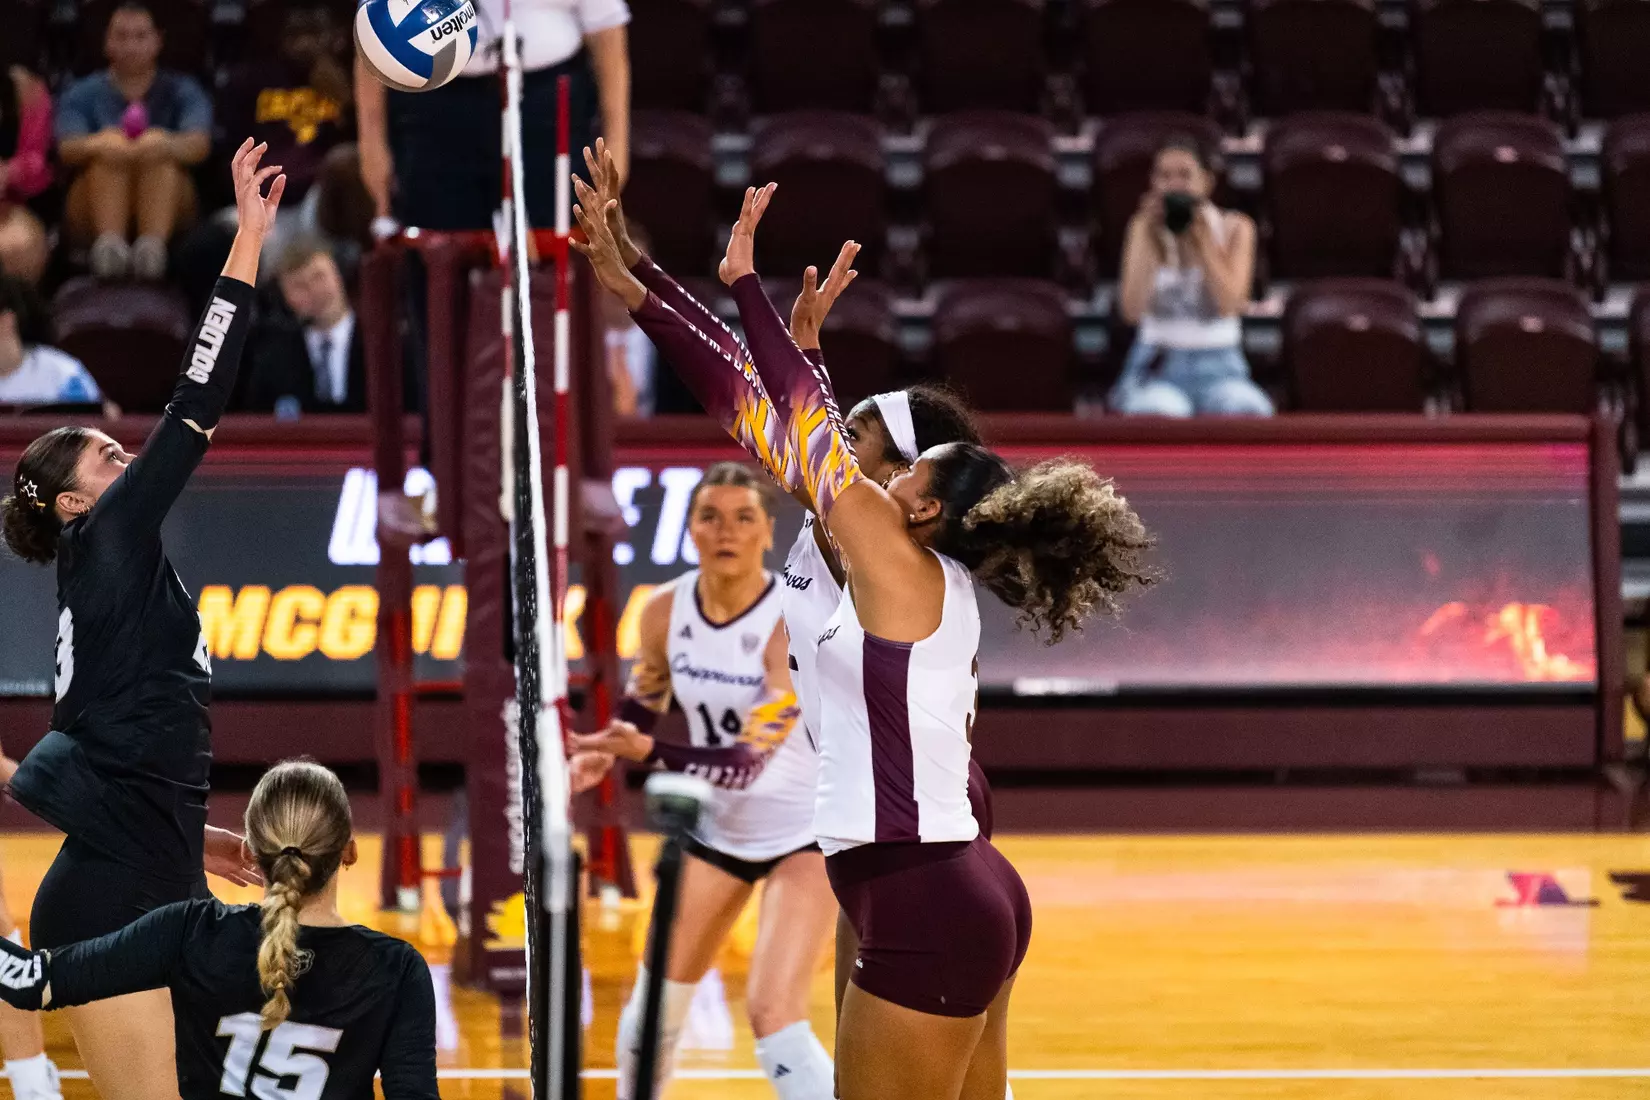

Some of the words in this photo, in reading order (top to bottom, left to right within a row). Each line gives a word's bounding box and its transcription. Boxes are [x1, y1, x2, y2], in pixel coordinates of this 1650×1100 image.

[430, 4, 475, 41] molten
[186, 296, 238, 385] GOLDEN
[215, 1011, 344, 1100] 15
